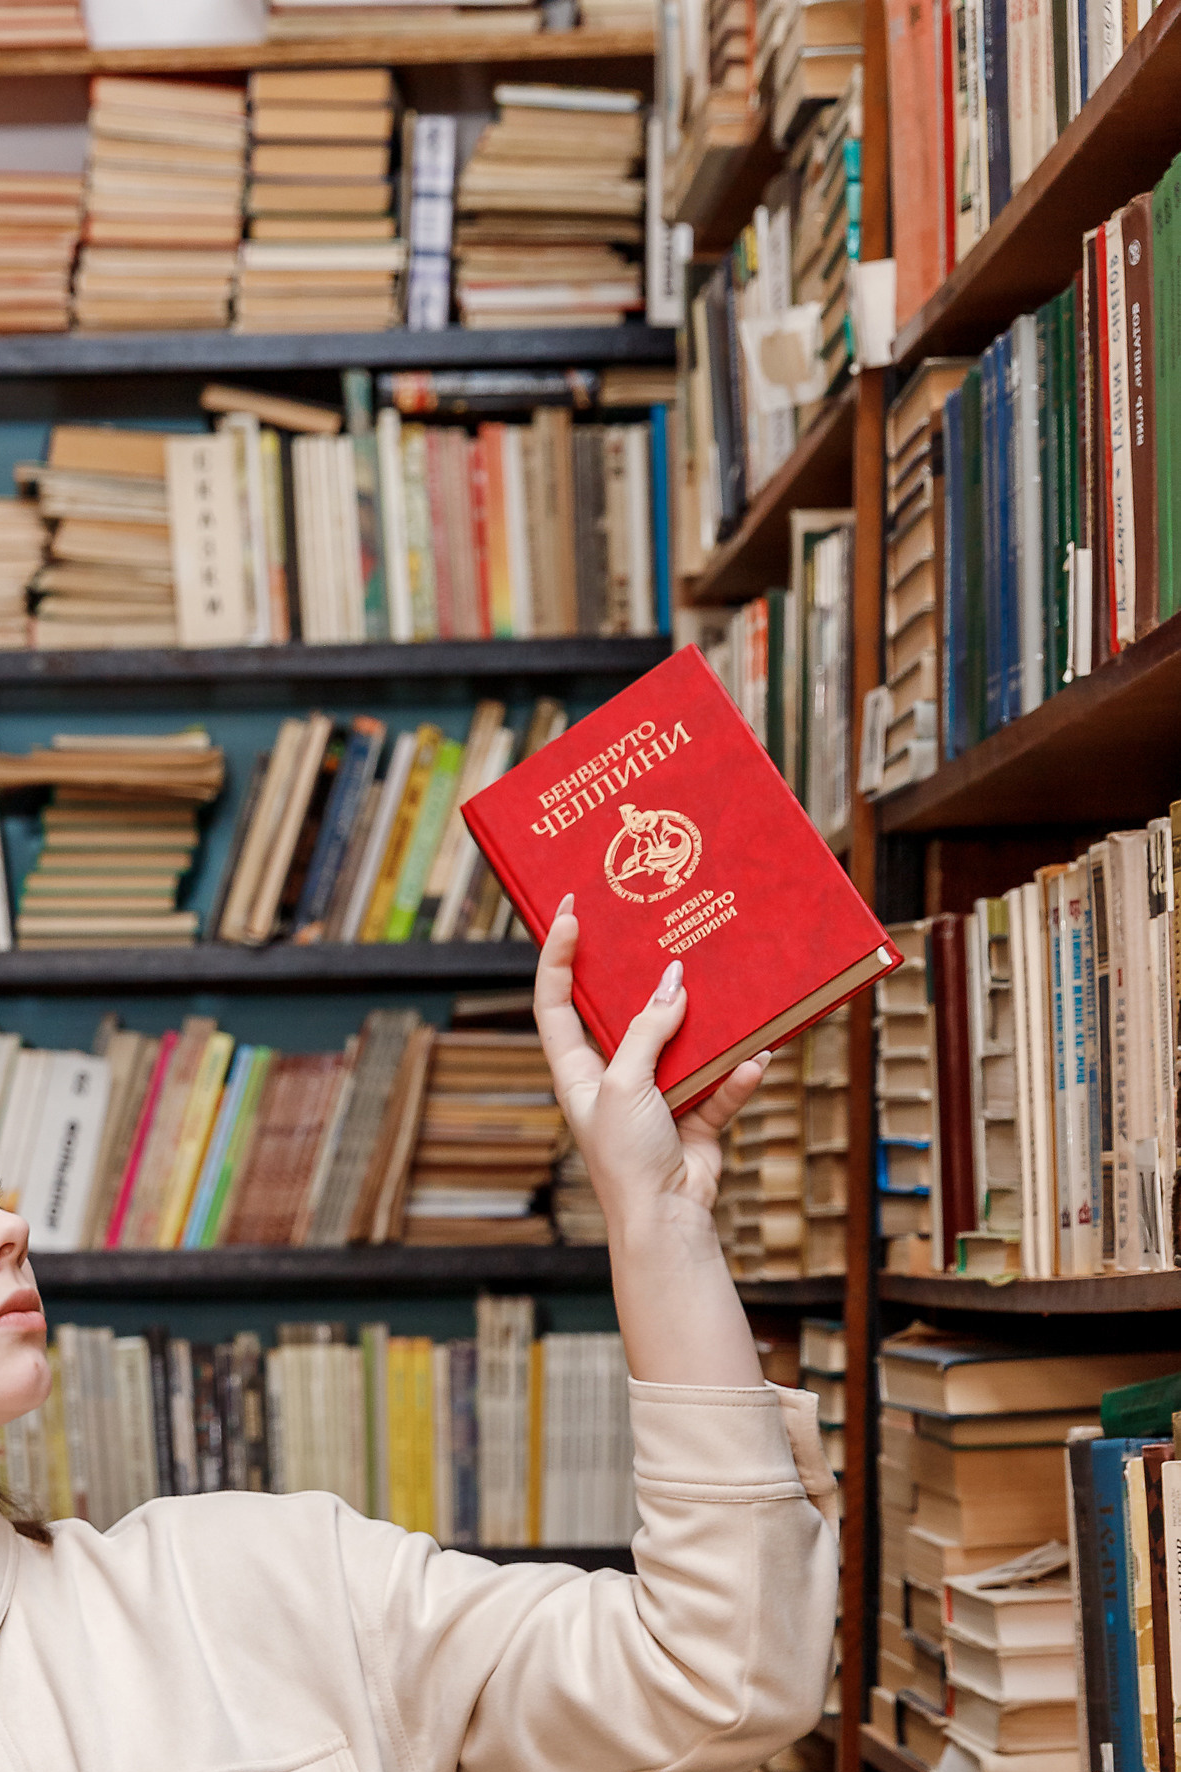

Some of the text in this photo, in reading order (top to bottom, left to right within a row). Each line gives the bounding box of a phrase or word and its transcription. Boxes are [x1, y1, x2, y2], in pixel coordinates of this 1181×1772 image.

[530, 719, 694, 839] ЧЕЛЛИНИ
[537, 720, 657, 810] БЕНВЕНУТО
[657, 890, 736, 949] БЕНВЕНУТО
[662, 889, 714, 927] ЖИЗНЬ
[669, 905, 738, 955] ЧЕЛЛИНИ
